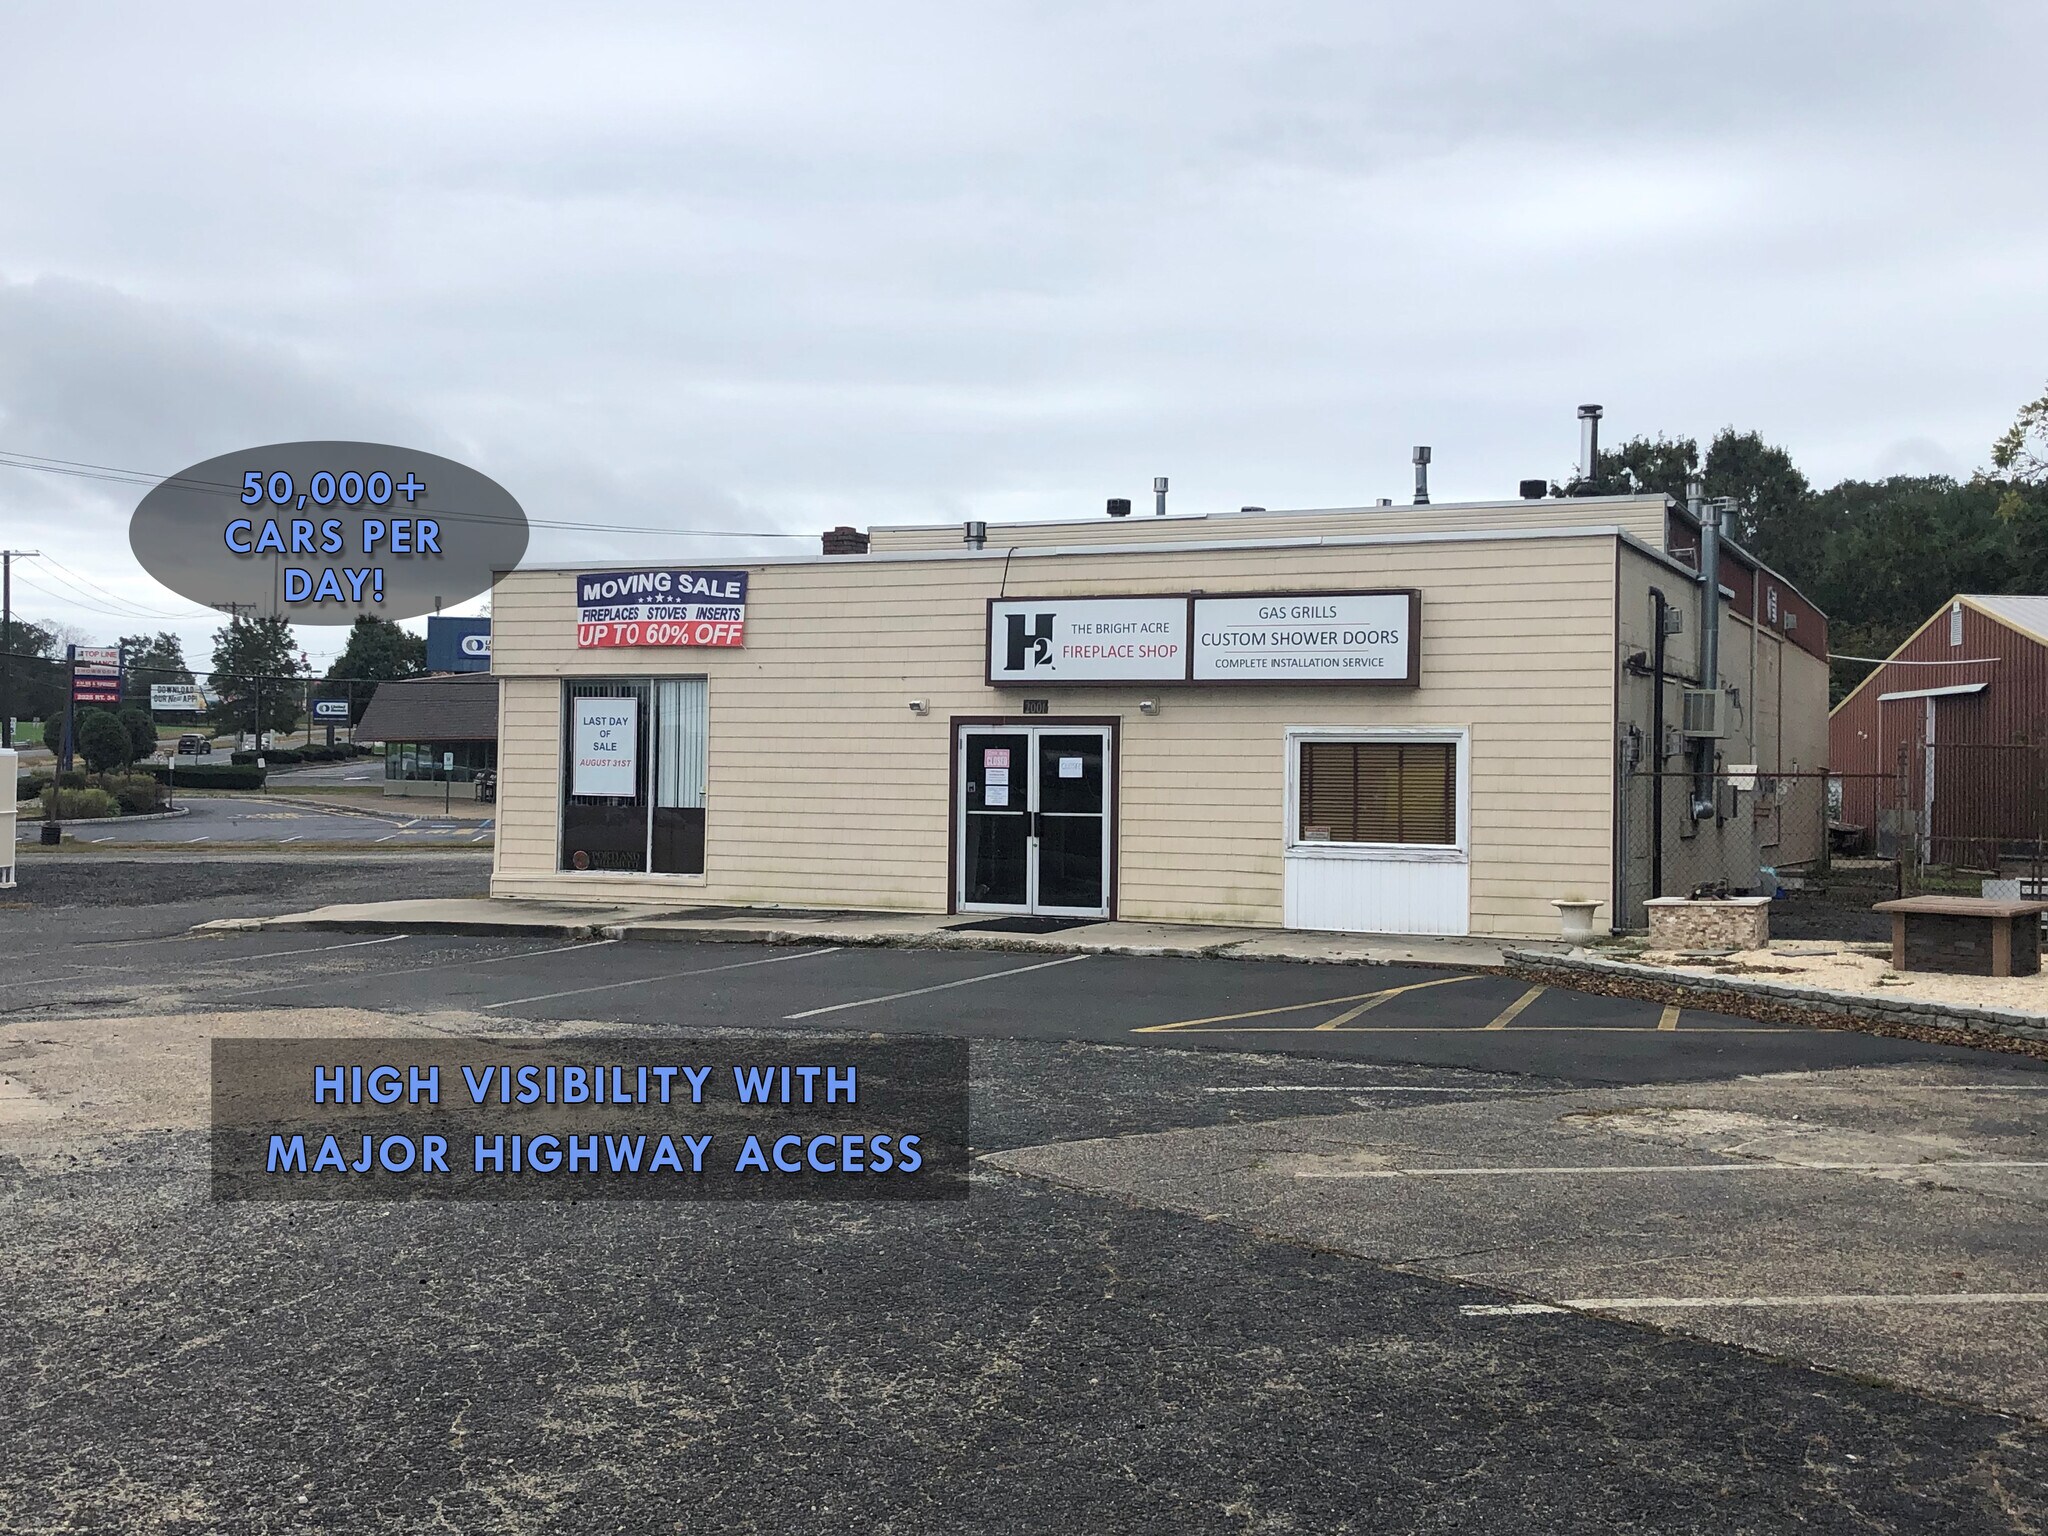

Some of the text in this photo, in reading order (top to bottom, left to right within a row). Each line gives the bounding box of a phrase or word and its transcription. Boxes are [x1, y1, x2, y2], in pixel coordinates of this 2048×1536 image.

[583, 572, 741, 601] MOVING SALE
[582, 606, 741, 622] FIREPLACES STOVES INSERTS
[1258, 605, 1337, 619] GAS GRILLS
[579, 623, 742, 646] UP TO 60% OFF
[1071, 622, 1170, 635] THE BRIGHT ACRE
[1201, 630, 1399, 647] CUSTOM SHOWER DOORS
[85, 650, 100, 658] TOP
[1063, 643, 1178, 659] FIREPLACE SHOP
[1215, 657, 1384, 669] COMPLETE INSTALLATION SERVICE
[583, 717, 629, 726] LAST DAY
[599, 729, 611, 738] OF
[593, 741, 617, 751] SALE
[579, 759, 632, 767] AUGUST 31ST
